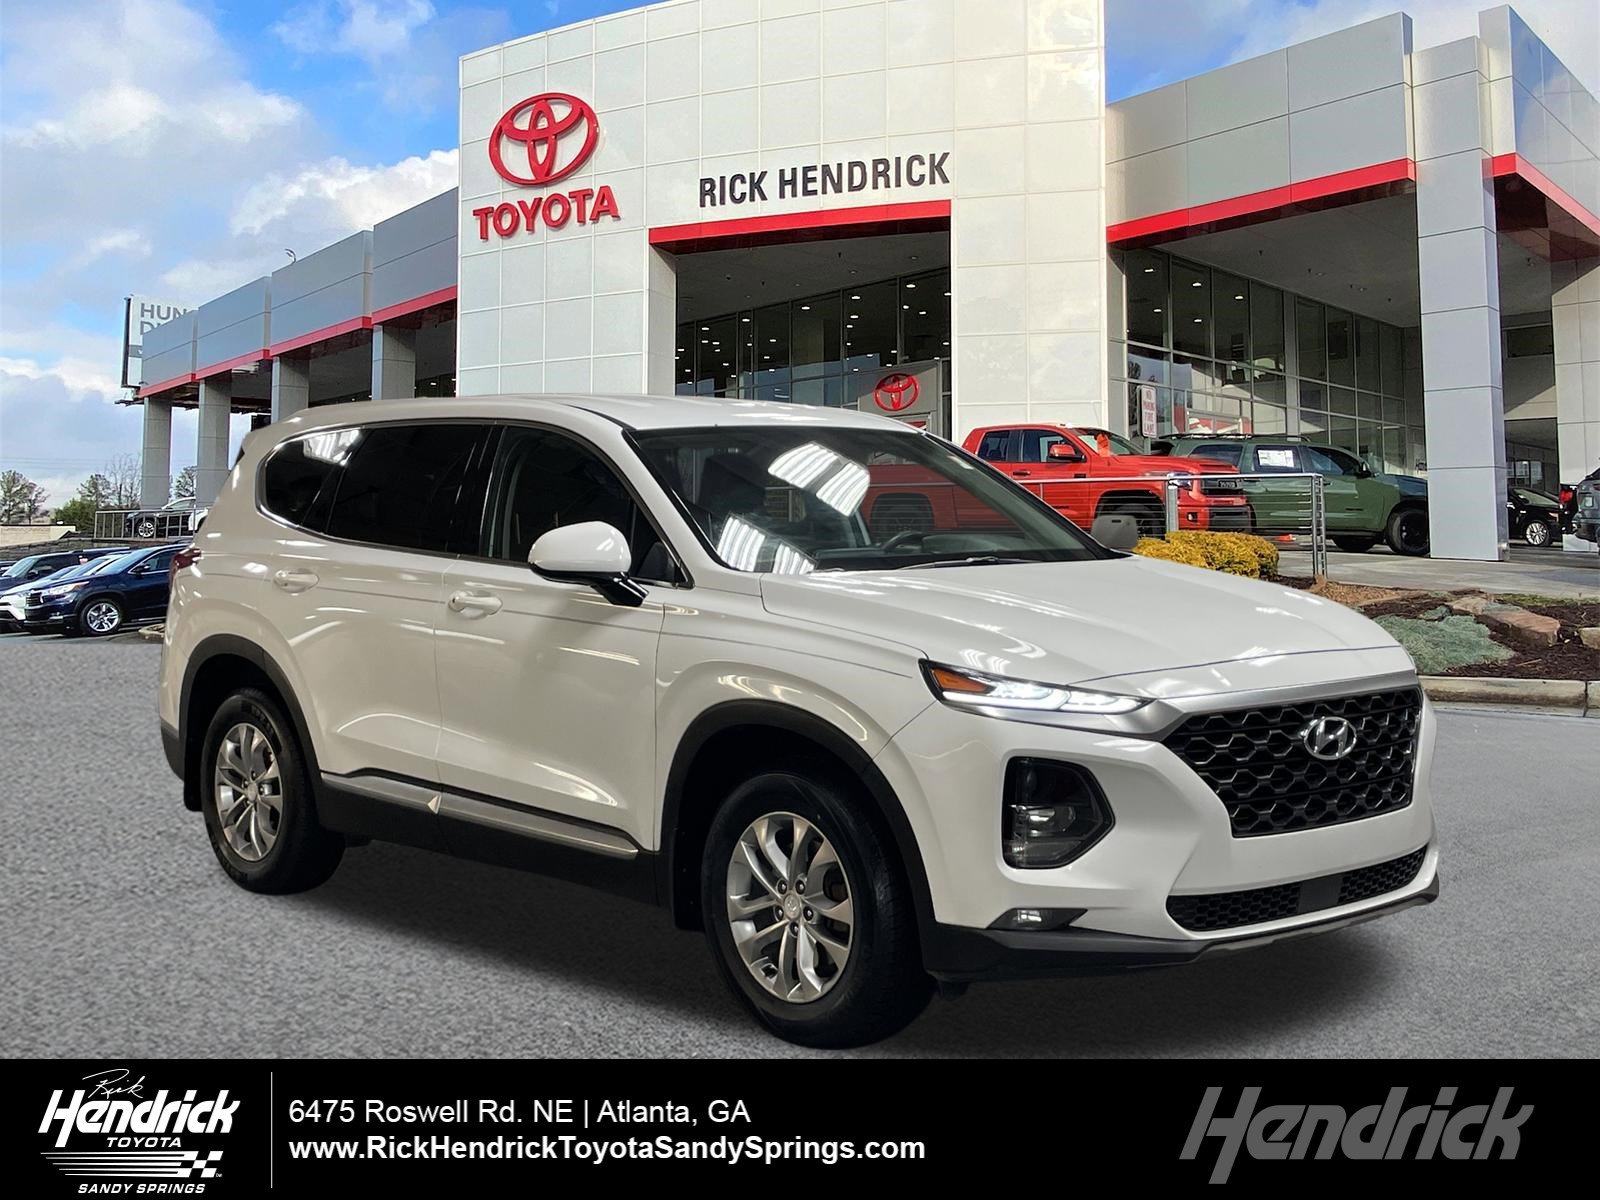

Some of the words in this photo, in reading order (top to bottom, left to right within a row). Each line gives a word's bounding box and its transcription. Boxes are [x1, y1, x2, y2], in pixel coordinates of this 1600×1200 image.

[700, 170, 768, 208] RICK
[779, 152, 950, 200] HENDRICK
[473, 185, 621, 240] TOYOTA
